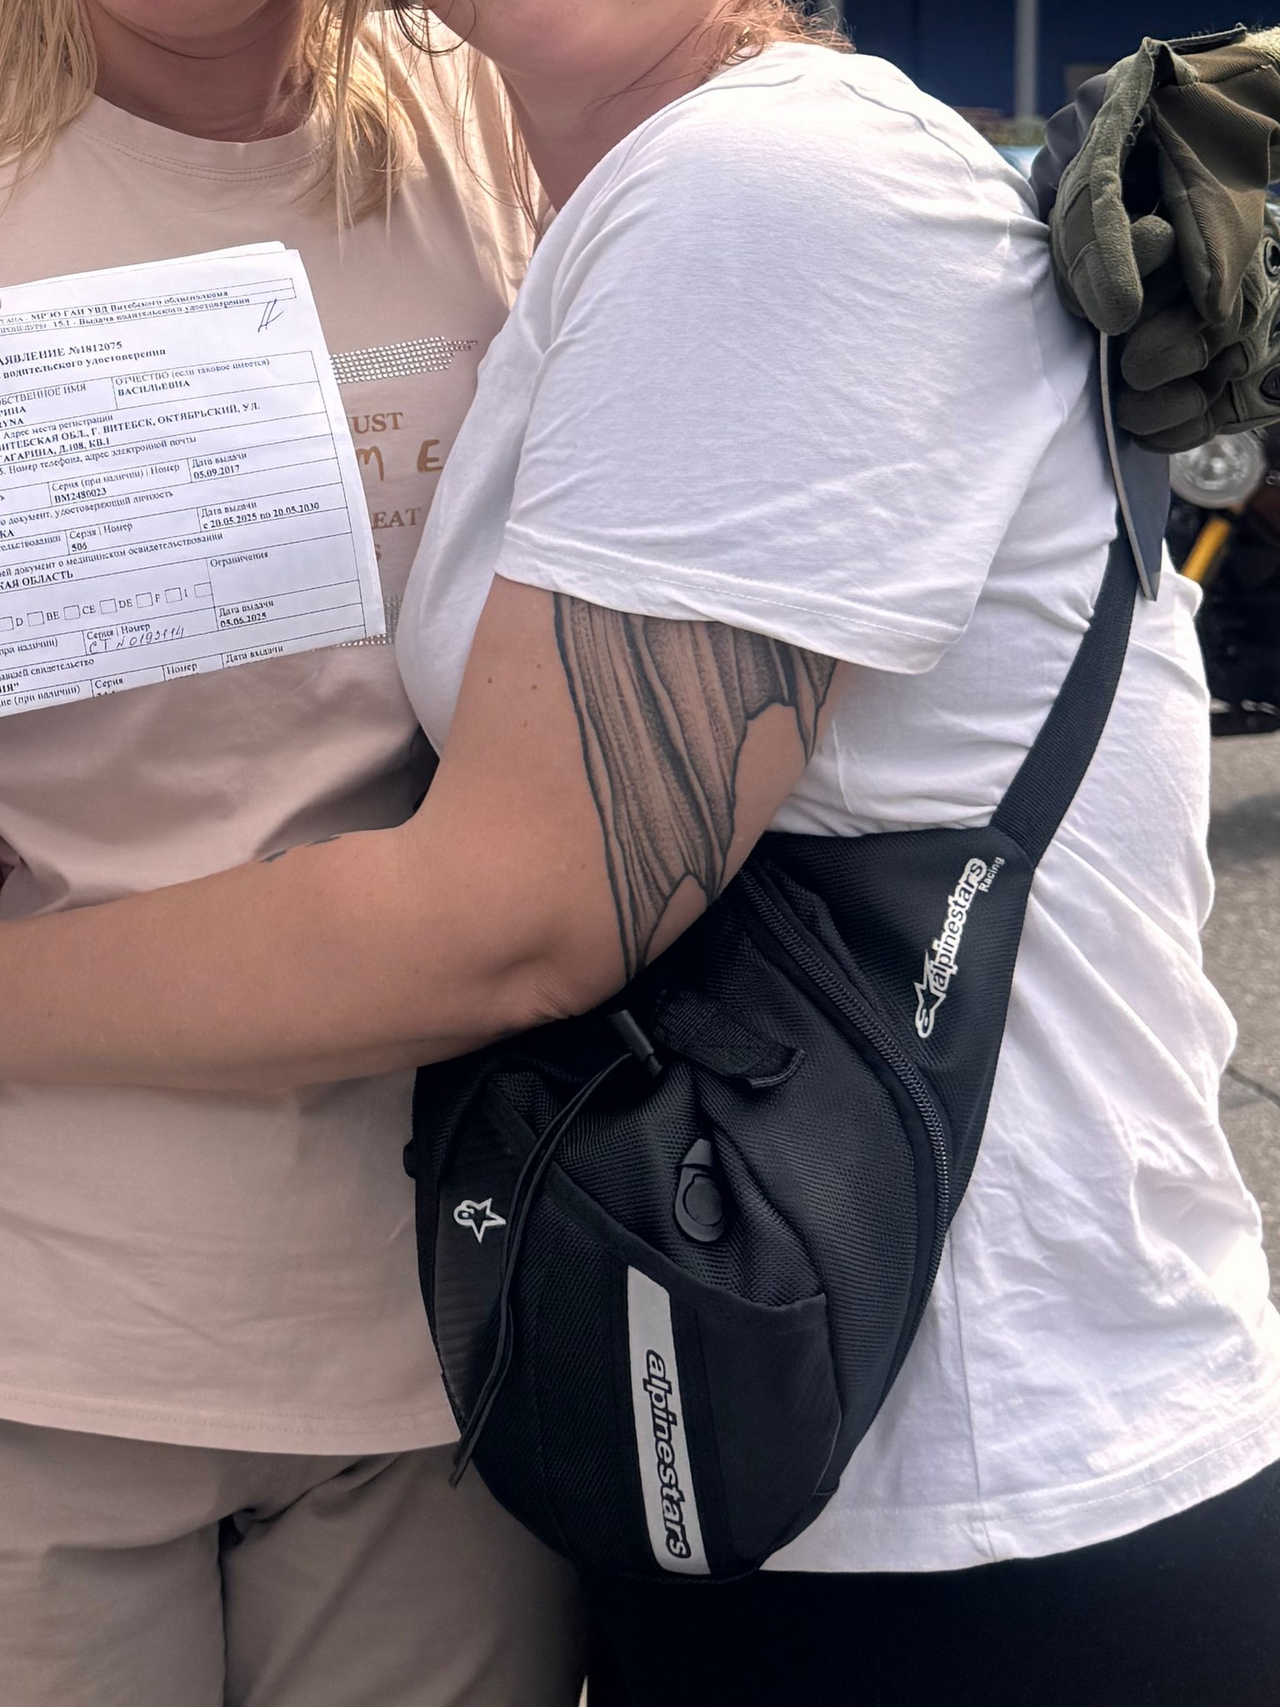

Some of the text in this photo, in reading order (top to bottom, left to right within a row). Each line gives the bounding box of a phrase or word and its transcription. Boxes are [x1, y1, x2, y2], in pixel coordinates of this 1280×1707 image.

[63, 308, 84, 318] ГАИ
[87, 304, 109, 315] УВД
[3, 359, 83, 380] водительского
[85, 348, 166, 368] удостоверения
[115, 371, 169, 386] ОТЧЕСТВО
[64, 383, 87, 395] ИМЯ
[117, 380, 191, 397] ВАСИЛЬЕВНА
[103, 417, 156, 434] ВИТЕБСК,
[157, 404, 240, 424] ОКТЯБРЬСКИЙ,
[242, 402, 261, 412] УЛ.
[350, 412, 403, 434] UST
[3, 414, 113, 441] Адрес места регистрации
[9, 461, 38, 476] Номер
[85, 451, 109, 464] адрес
[169, 434, 197, 447] почты
[192, 452, 247, 469] Дата выдачи
[52, 479, 79, 493] Серия
[150, 463, 180, 476] Номер
[201, 501, 257, 519] Дата выдачи
[372, 507, 420, 530] EAT
[210, 512, 258, 528] 20.05.2025
[260, 511, 272, 521] по
[69, 522, 133, 541] Серия Номер
[210, 551, 268, 568] Ограничения
[22, 569, 74, 587] ОБЛАСТЬ
[15, 617, 24, 627] D
[82, 605, 96, 615] CE
[119, 599, 133, 609] DE
[219, 600, 274, 617] Дата выдачи
[86, 622, 151, 642] Серия Номер
[225, 645, 284, 663] Дата выдачи
[30, 658, 95, 676] свидетельство
[166, 663, 197, 676] Номер
[94, 678, 124, 691] Серия
[14, 692, 36, 706] (при
[977, 856, 1005, 893] Racing
[930, 857, 988, 995] alpinestars
[643, 1349, 692, 1559] alpinestars
